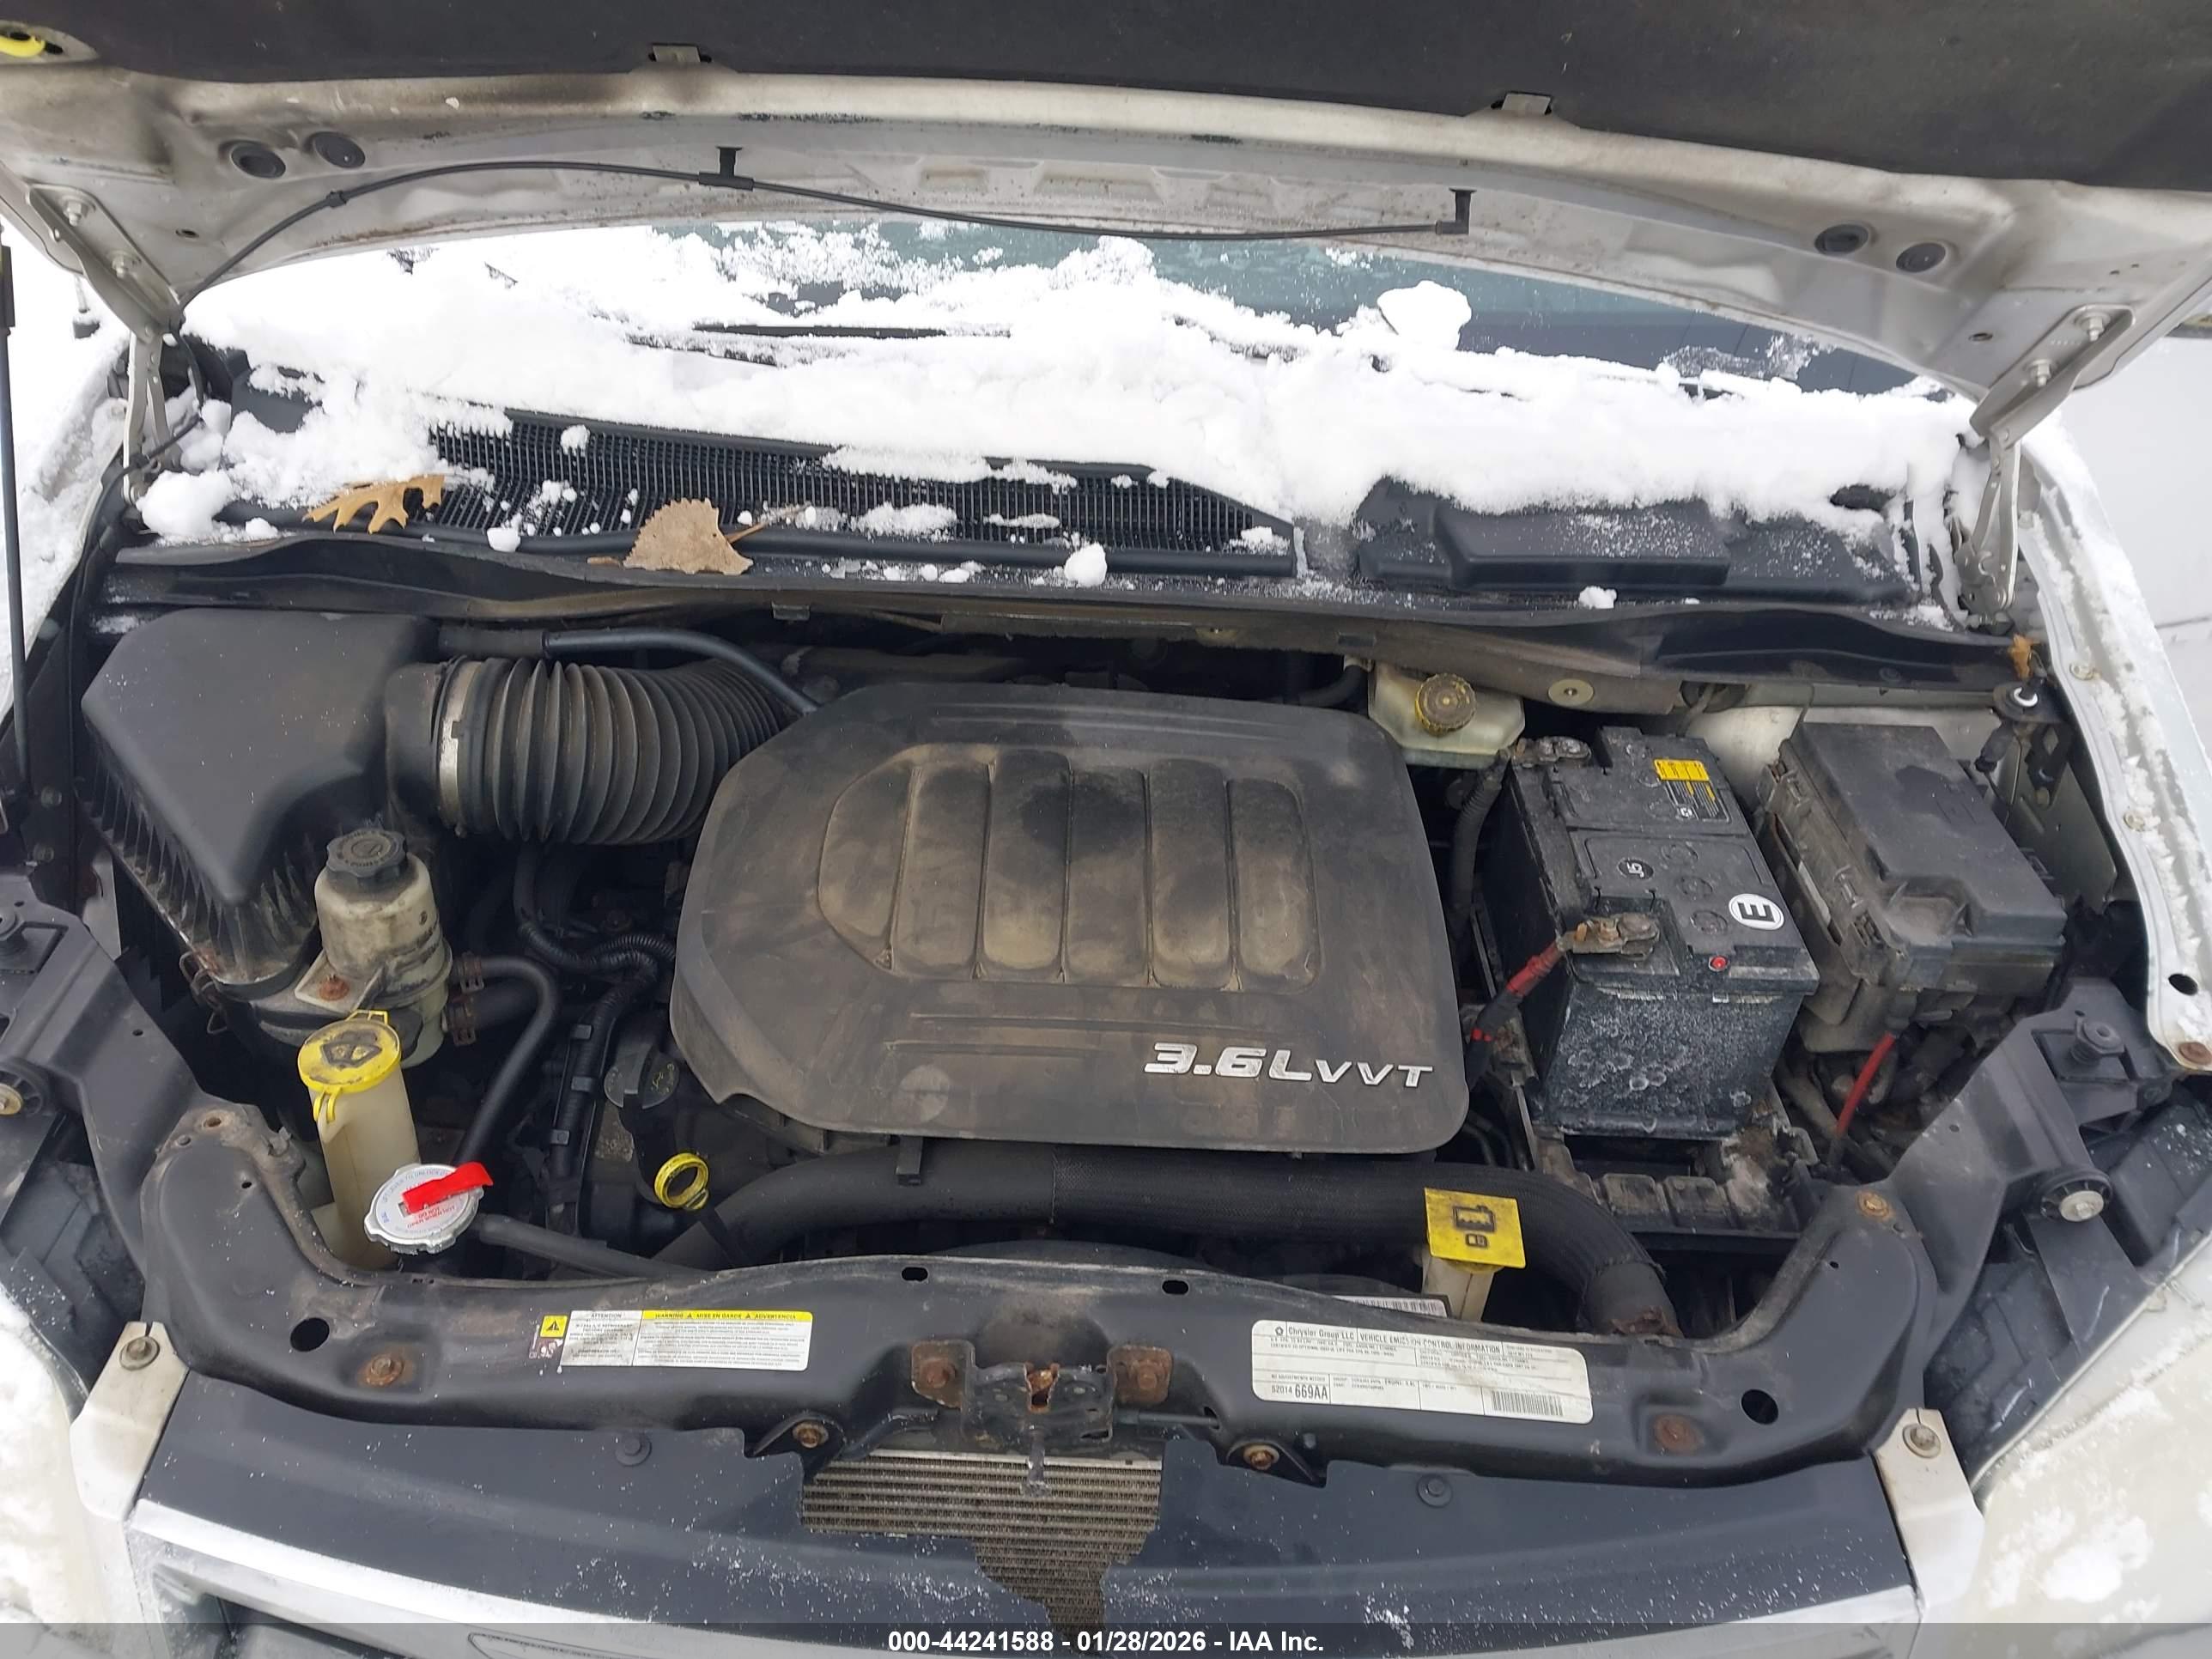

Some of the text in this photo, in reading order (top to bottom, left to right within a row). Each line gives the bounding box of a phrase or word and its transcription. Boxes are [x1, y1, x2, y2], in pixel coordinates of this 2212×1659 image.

[1737, 902, 1777, 923] E
[1289, 1326, 1354, 1340] Chrysler Group LLC
[1360, 1333, 1386, 1344] VEHICLE
[1423, 1339, 1453, 1349] CONTROL
[1455, 1341, 1501, 1354] INFORMATION
[1295, 1384, 1328, 1400] 669AA
